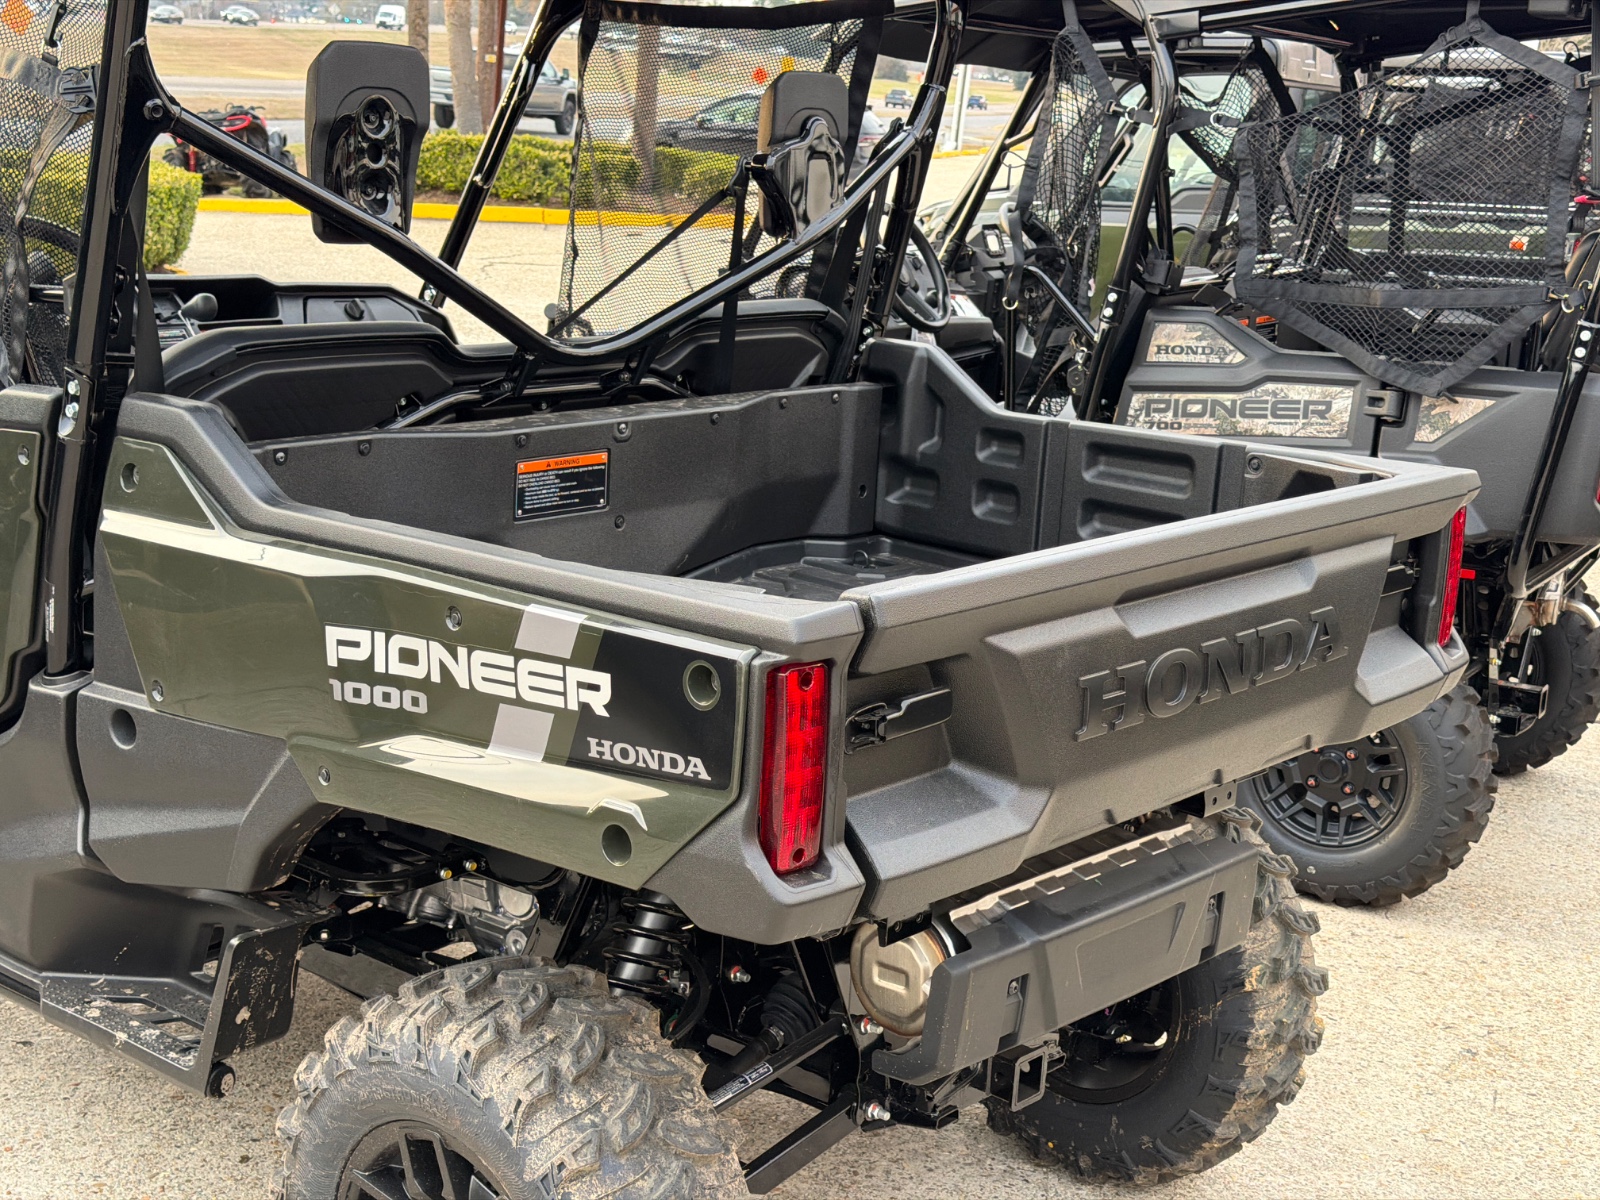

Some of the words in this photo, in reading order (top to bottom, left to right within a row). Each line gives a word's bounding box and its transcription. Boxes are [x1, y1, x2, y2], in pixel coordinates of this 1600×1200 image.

[1155, 344, 1230, 356] HONDA
[1145, 398, 1333, 420] PIONEER
[1144, 421, 1182, 430] 700
[554, 458, 580, 467] WARNING
[324, 625, 612, 717] PIONEER
[1075, 605, 1349, 742] HONDA
[328, 678, 428, 714] 1000
[586, 737, 711, 781] HONDA
